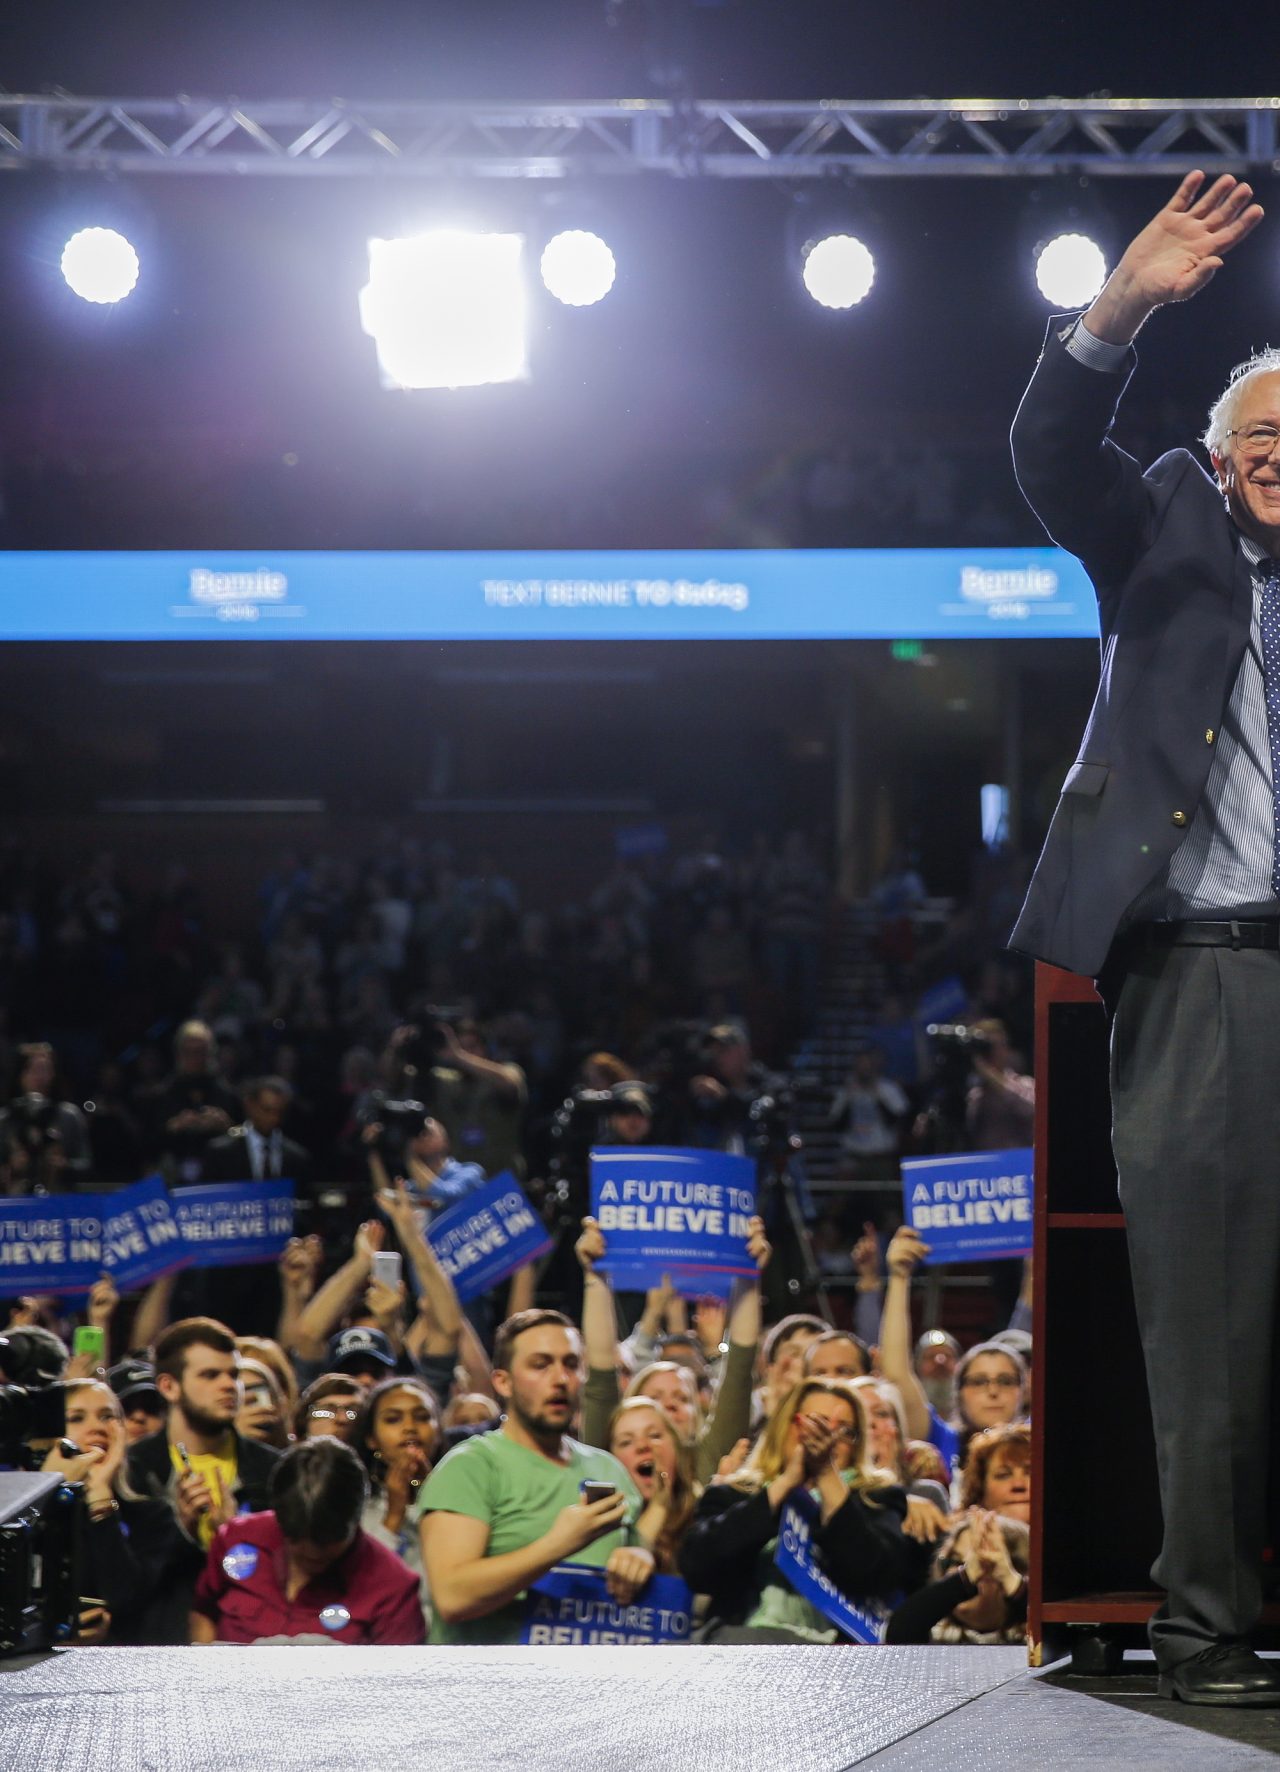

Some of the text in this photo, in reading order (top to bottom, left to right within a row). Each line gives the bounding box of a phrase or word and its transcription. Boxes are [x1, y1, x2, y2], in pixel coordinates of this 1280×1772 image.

[545, 580, 632, 607] BERNIE
[634, 579, 672, 606] TO
[600, 1180, 754, 1213] A FUTURE TO
[912, 1175, 1028, 1204] A FUTURE
[0, 1219, 64, 1241] TURE
[68, 1217, 101, 1239] TO
[434, 1192, 524, 1257] UTURE TO
[598, 1205, 725, 1236] BELIEVE
[912, 1197, 1032, 1230] BELIEVE
[0, 1240, 100, 1265] IEVE IN
[440, 1208, 536, 1275] LIEVE IN
[558, 1598, 654, 1631] FUTURE
[657, 1609, 689, 1635] TO
